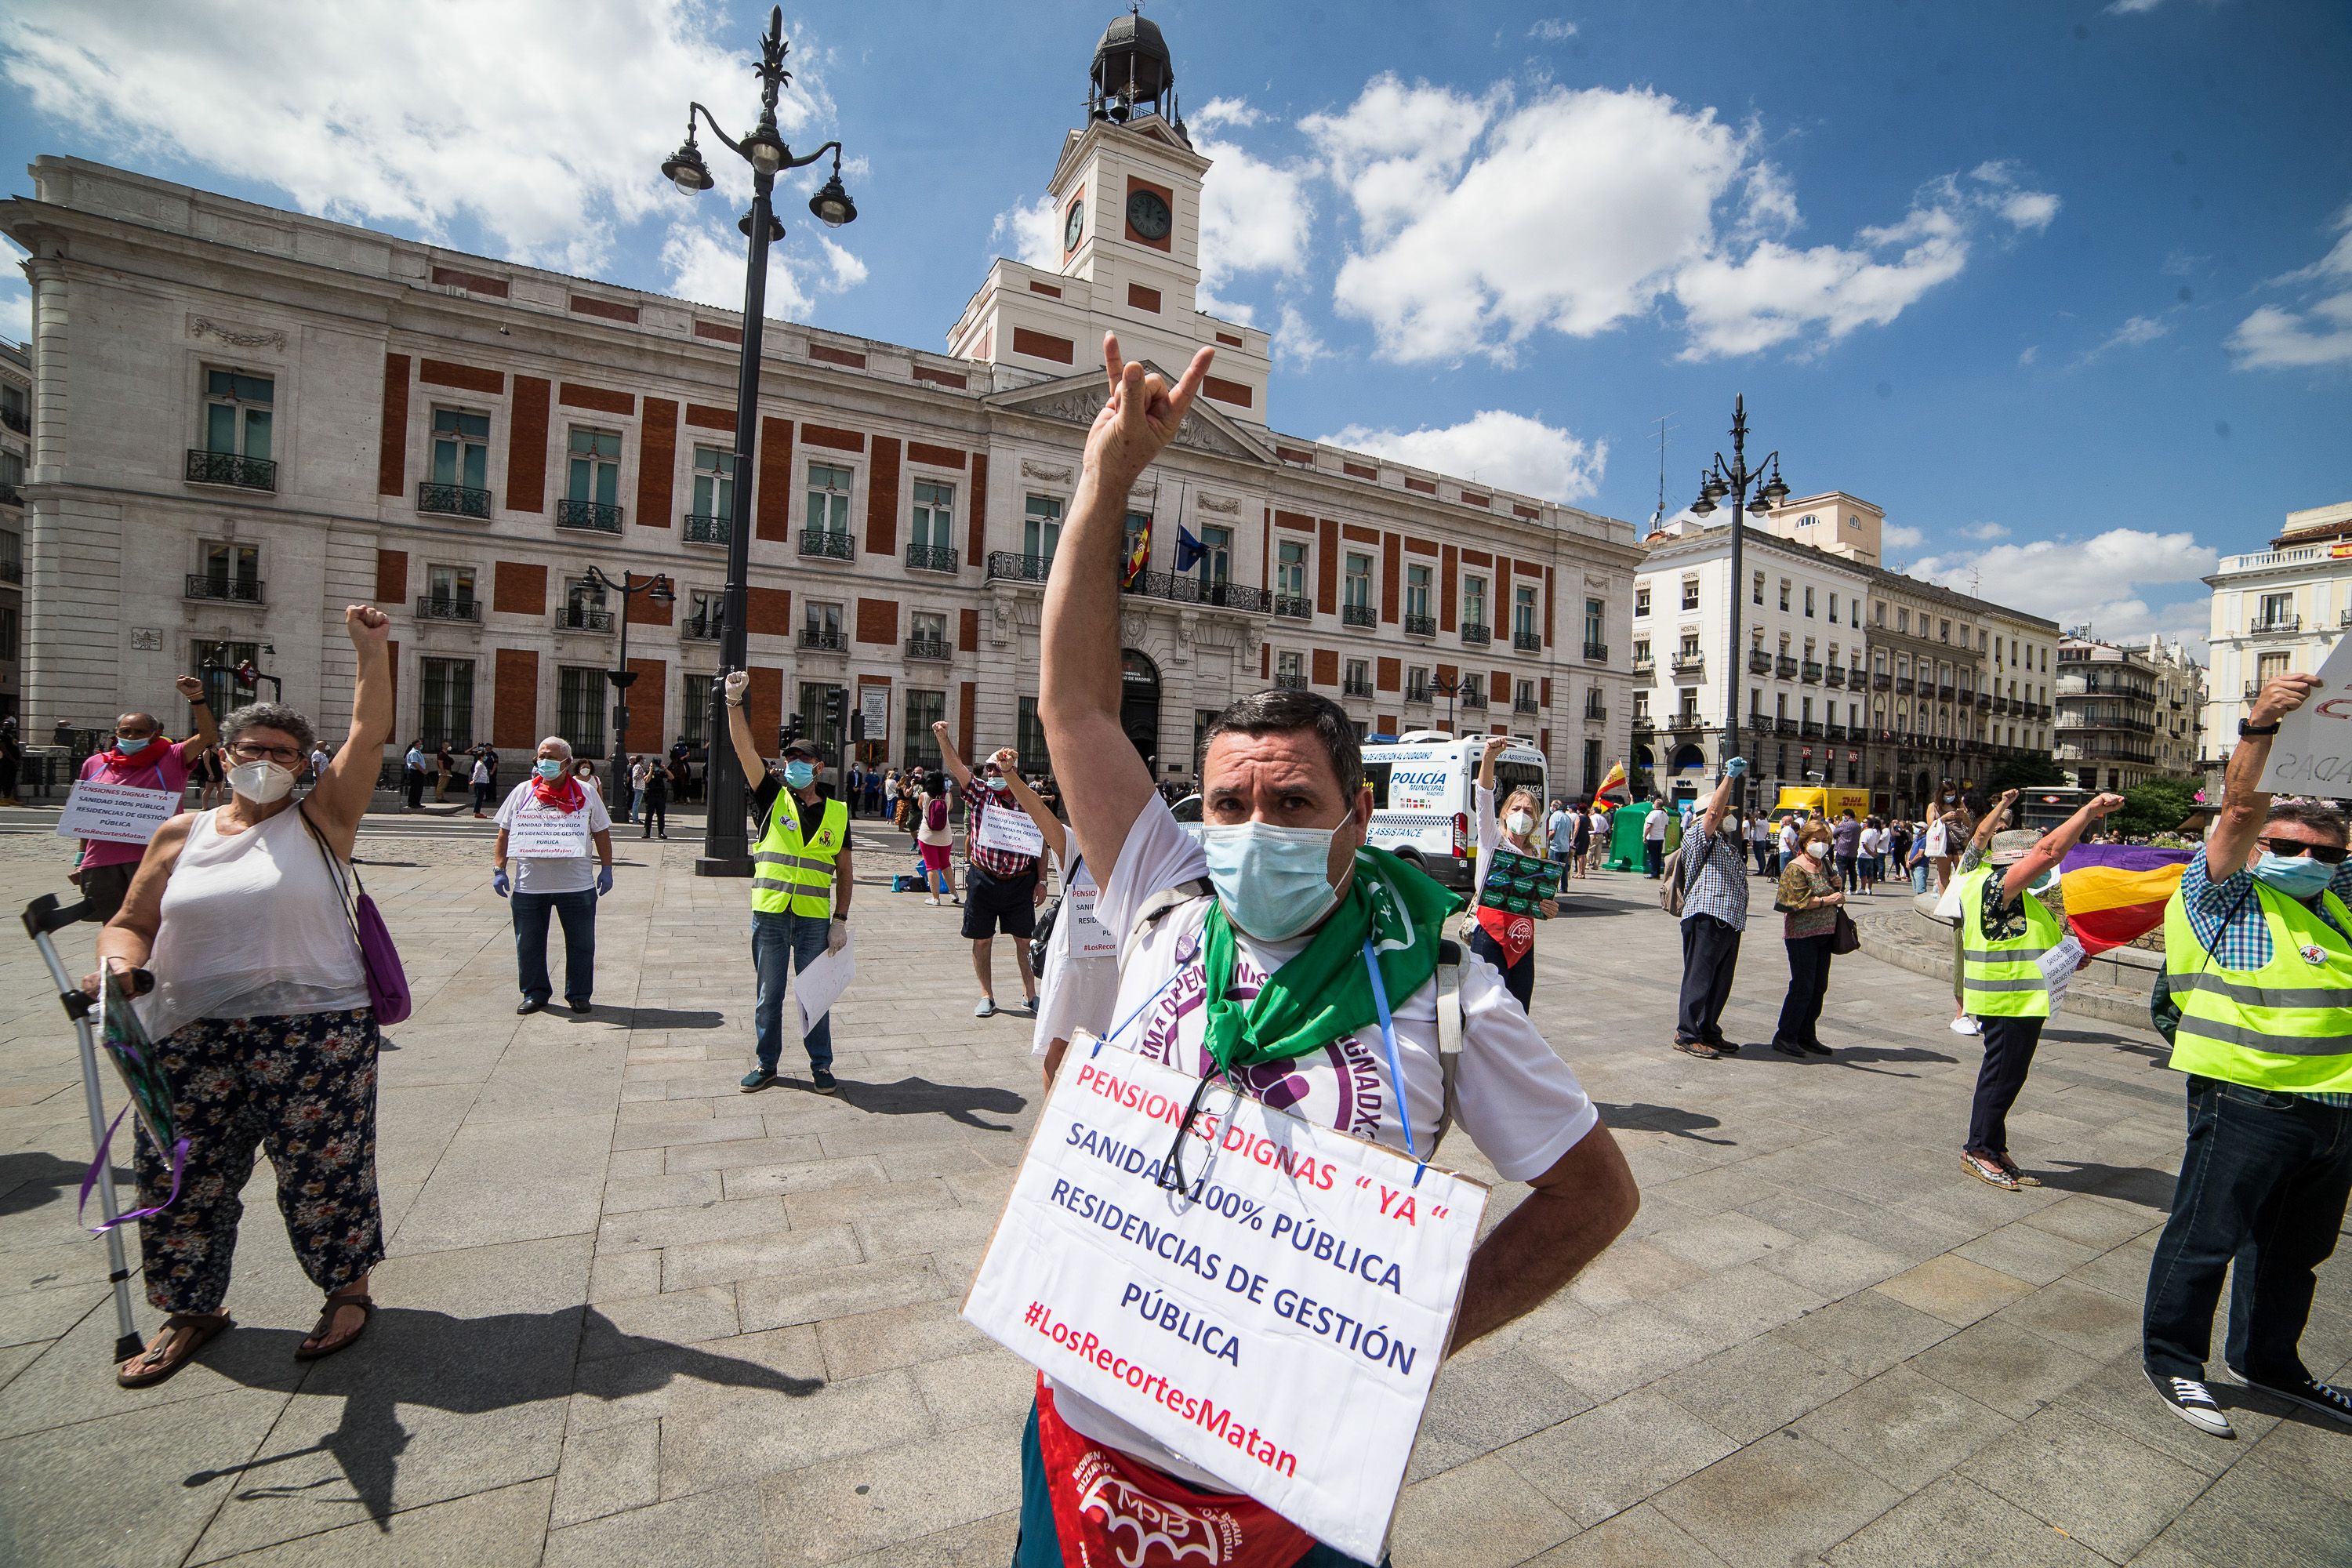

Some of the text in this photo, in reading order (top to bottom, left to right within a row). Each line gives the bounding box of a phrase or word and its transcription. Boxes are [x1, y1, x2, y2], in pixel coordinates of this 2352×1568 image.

[1390, 770, 1447, 784] POLICÍA
[78, 786, 120, 795] PENSIONES
[121, 790, 150, 799] DIGNAS
[78, 796, 113, 805] SANIDAD
[135, 802, 165, 811] PÚBLICA
[75, 806, 124, 816] RESIDENCIAS
[137, 812, 169, 821] GESTIÓN
[100, 818, 131, 827] PÚBLICA
[987, 822, 1016, 833] RESIDENCIAS
[73, 827, 147, 840] #LosRecortesMatan
[1374, 828, 1424, 837] ASSISTANCE
[2046, 951, 2063, 966] SANIDAD
[2065, 951, 2082, 967] RECORTES
[2052, 973, 2068, 986] MEDIOS
[1076, 1064, 1220, 1141] PENSIONES
[1222, 1124, 1337, 1190] DIGNAS
[1187, 1178, 1266, 1231] 100%
[1271, 1213, 1402, 1294] PÚBLICA
[1051, 1178, 1417, 1375] RESIDENCIAS DE GESTIÓN
[1120, 1282, 1240, 1367] PÚBLICA
[1024, 1300, 1298, 1479] #LosRecortesMatan
